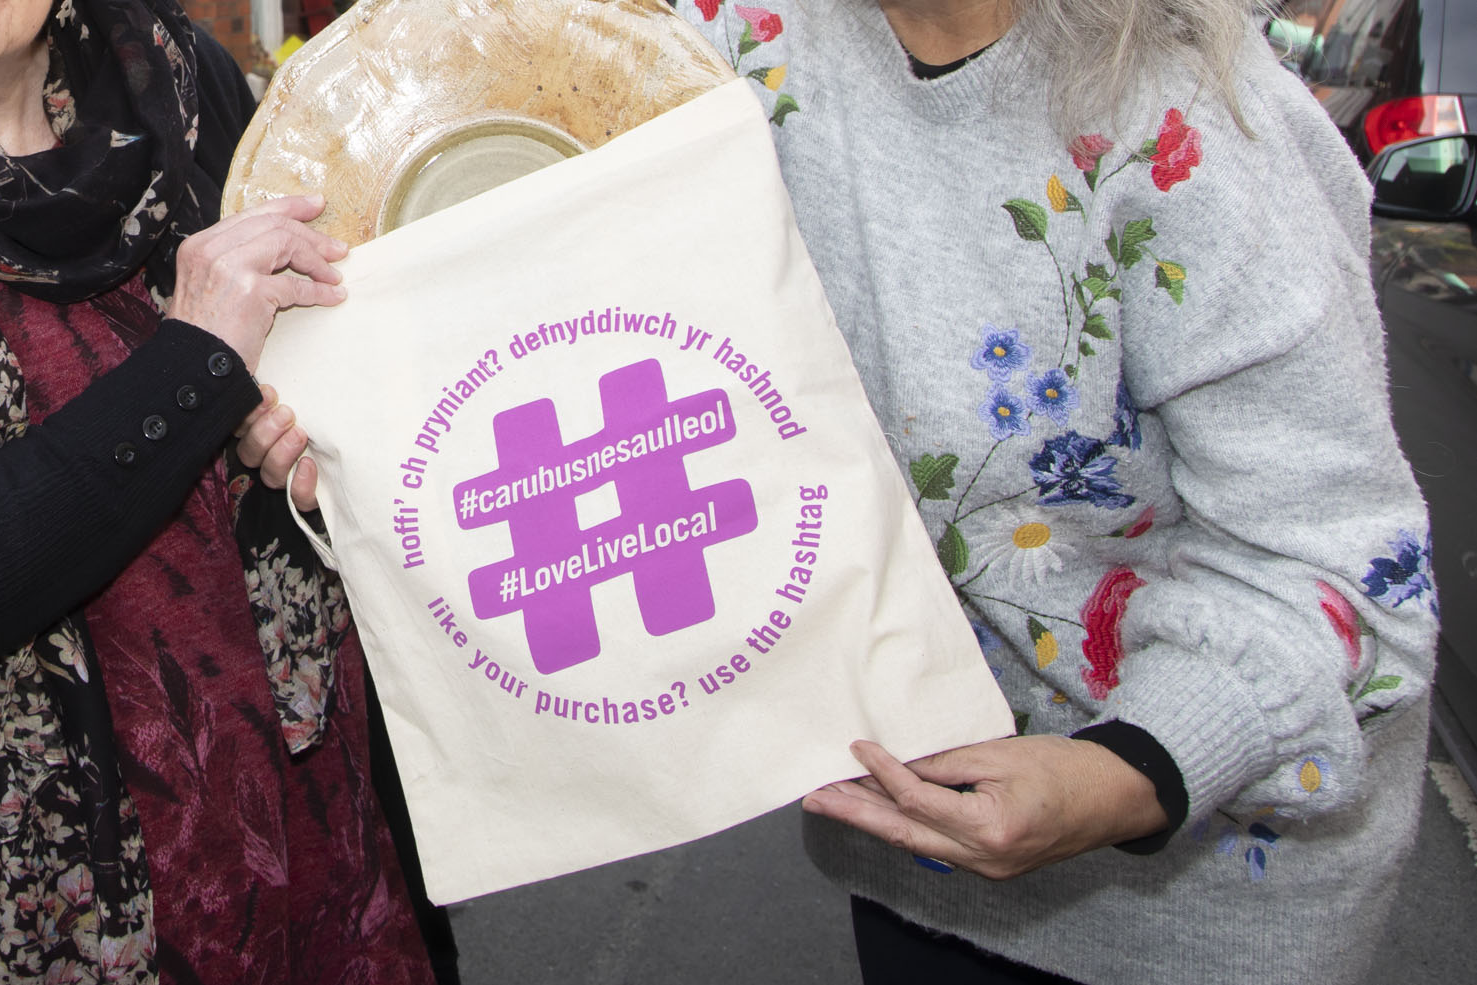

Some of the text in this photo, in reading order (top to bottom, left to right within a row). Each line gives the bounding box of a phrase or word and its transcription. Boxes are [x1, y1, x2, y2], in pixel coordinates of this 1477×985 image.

[400, 457, 428, 489] ch
[414, 349, 504, 454] pryniant?
[509, 306, 677, 359] defnyddiwch
[679, 325, 713, 351] yr
[713, 337, 808, 440] hashnod
[459, 400, 726, 520] #carubusnesaulleol
[427, 484, 829, 725] like your purchase? use the hashtag
[499, 501, 717, 603] #LoveLiveLocal
